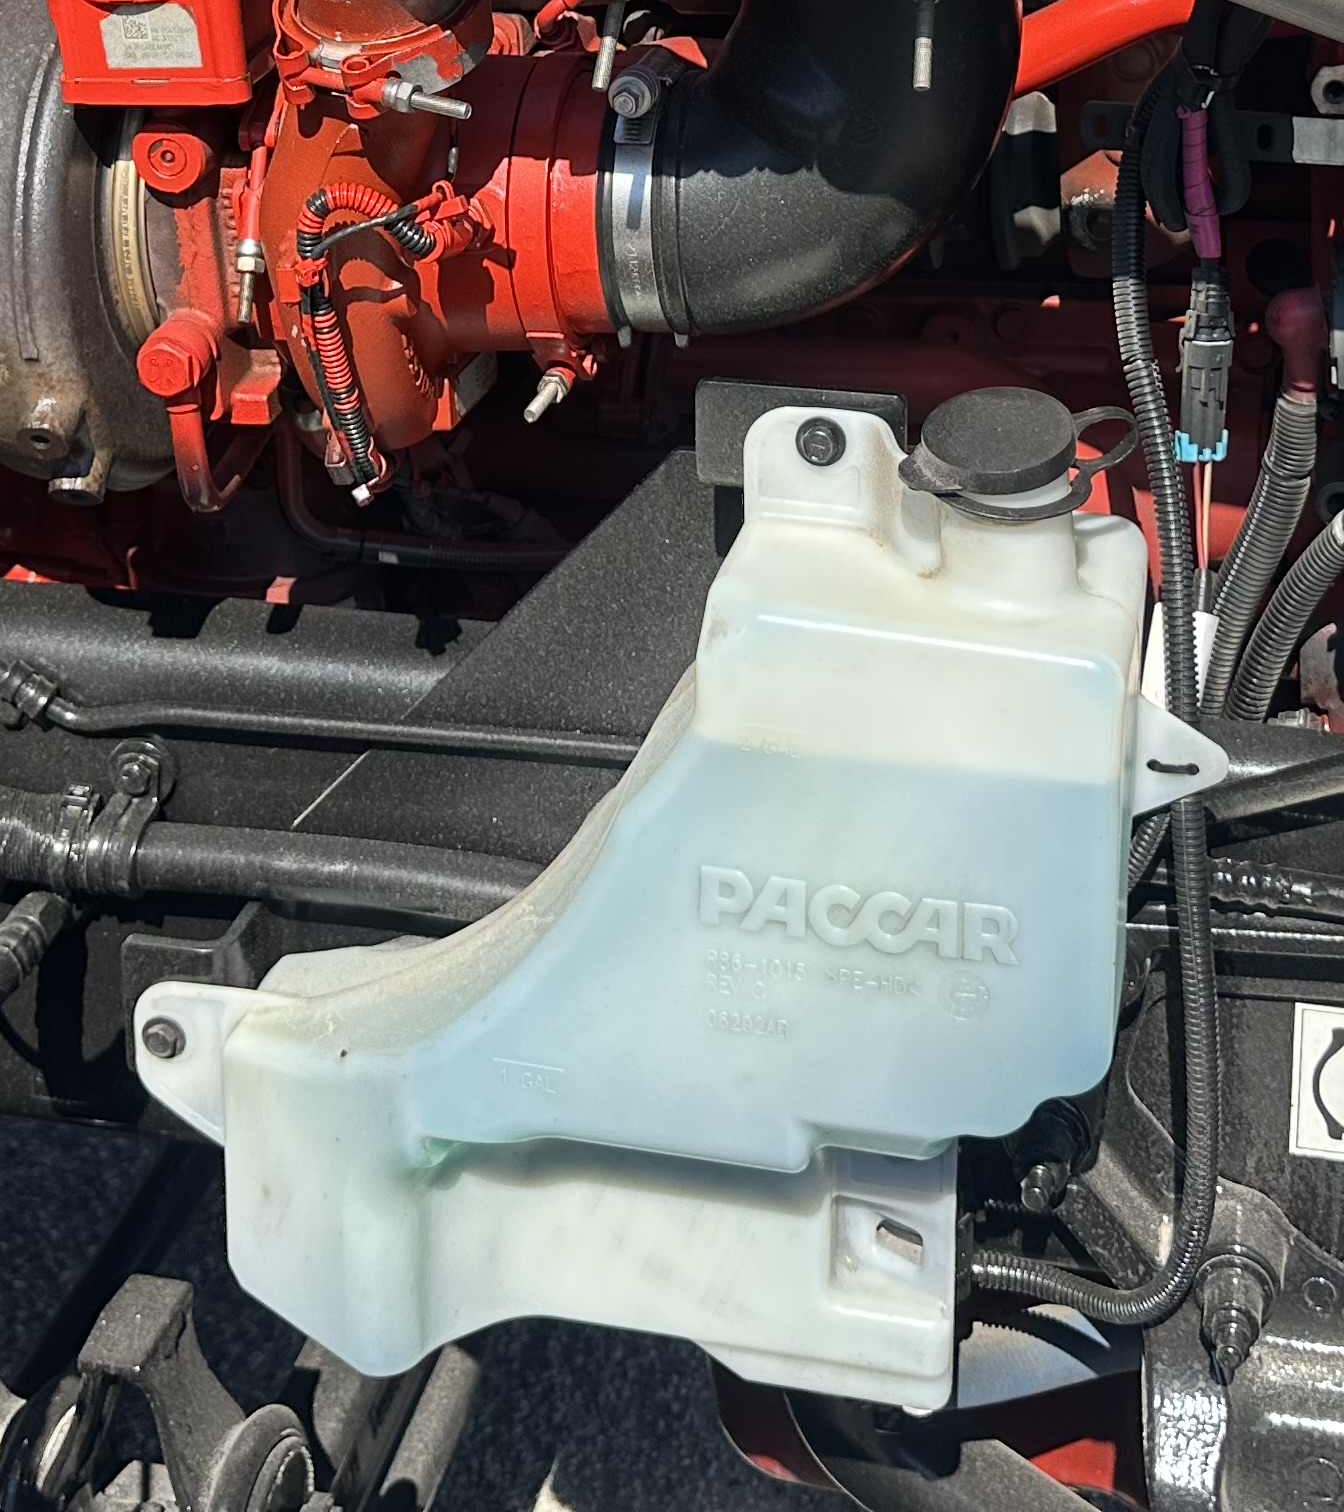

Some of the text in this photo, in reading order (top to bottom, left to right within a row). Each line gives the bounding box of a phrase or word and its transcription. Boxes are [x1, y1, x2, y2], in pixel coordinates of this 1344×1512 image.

[699, 864, 1020, 965] PACCAR
[706, 973, 767, 999] REV C
[520, 1071, 558, 1095] GAL
